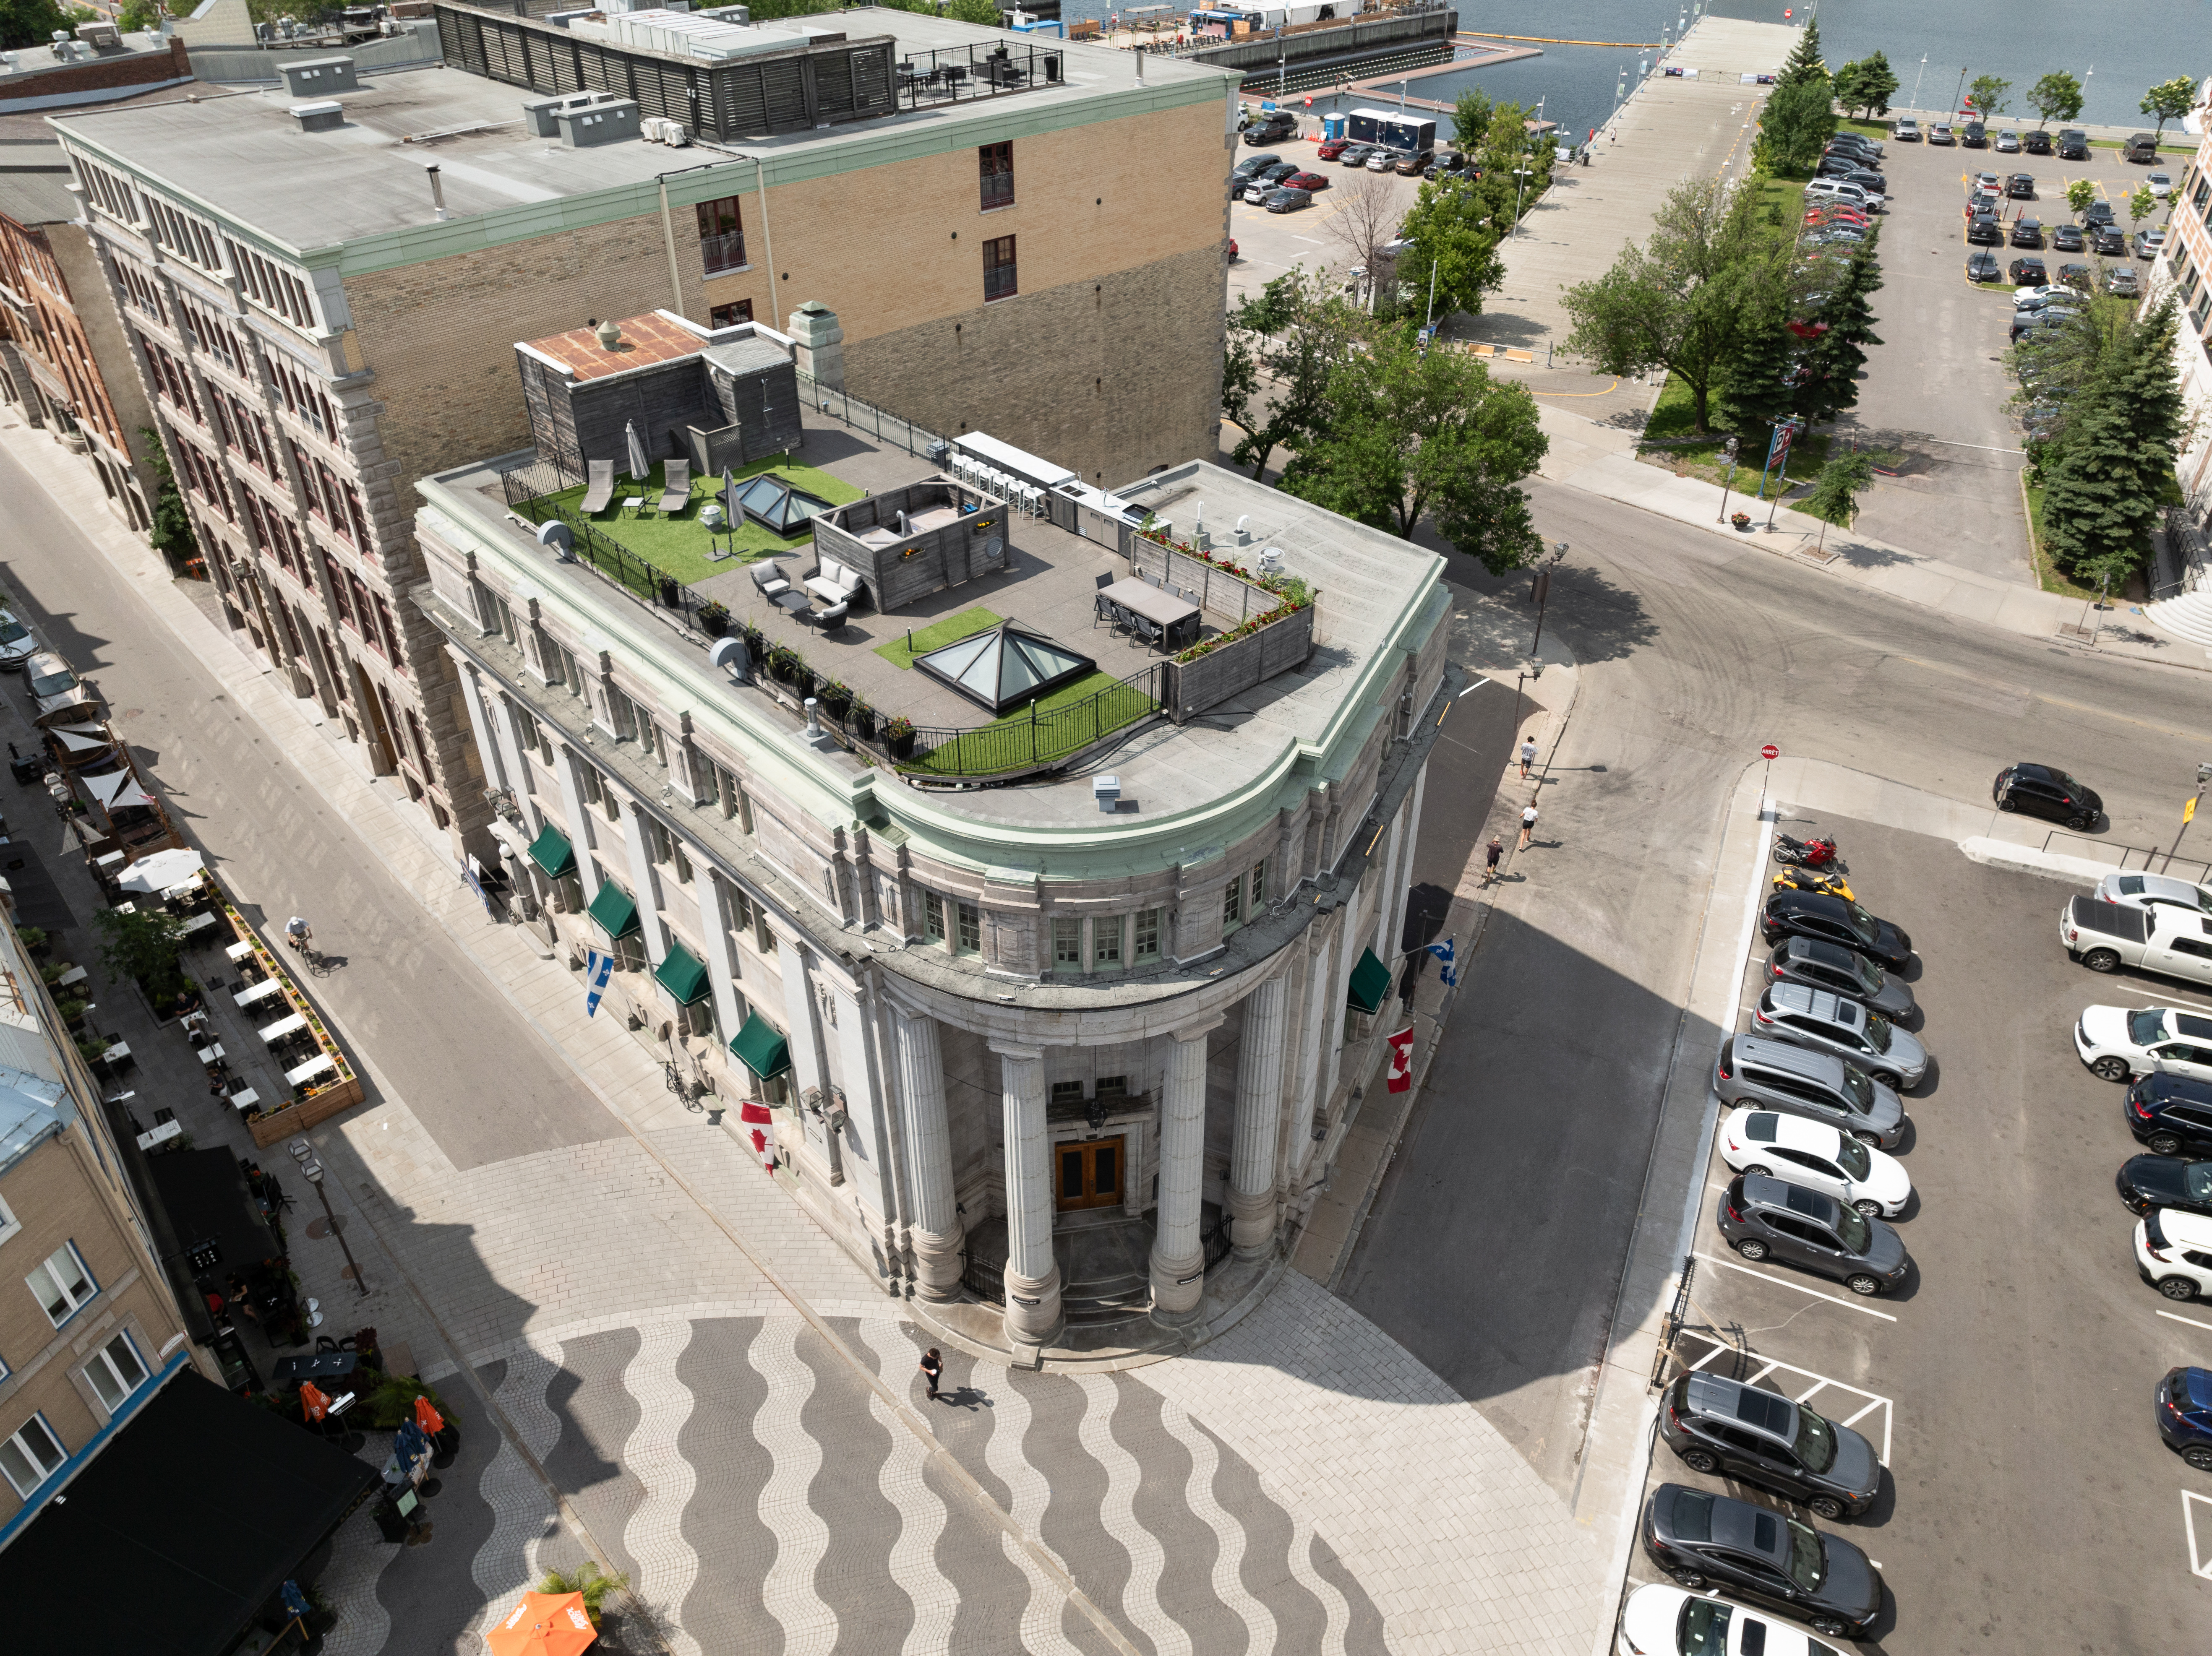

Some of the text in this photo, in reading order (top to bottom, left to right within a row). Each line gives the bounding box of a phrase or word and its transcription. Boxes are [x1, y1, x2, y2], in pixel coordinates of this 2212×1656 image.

[1775, 433, 1784, 451] P
[1180, 1273, 1201, 1284] NORPLEX
[566, 1607, 587, 1629] APEROL
[574, 1609, 589, 1625] SPRITZ
